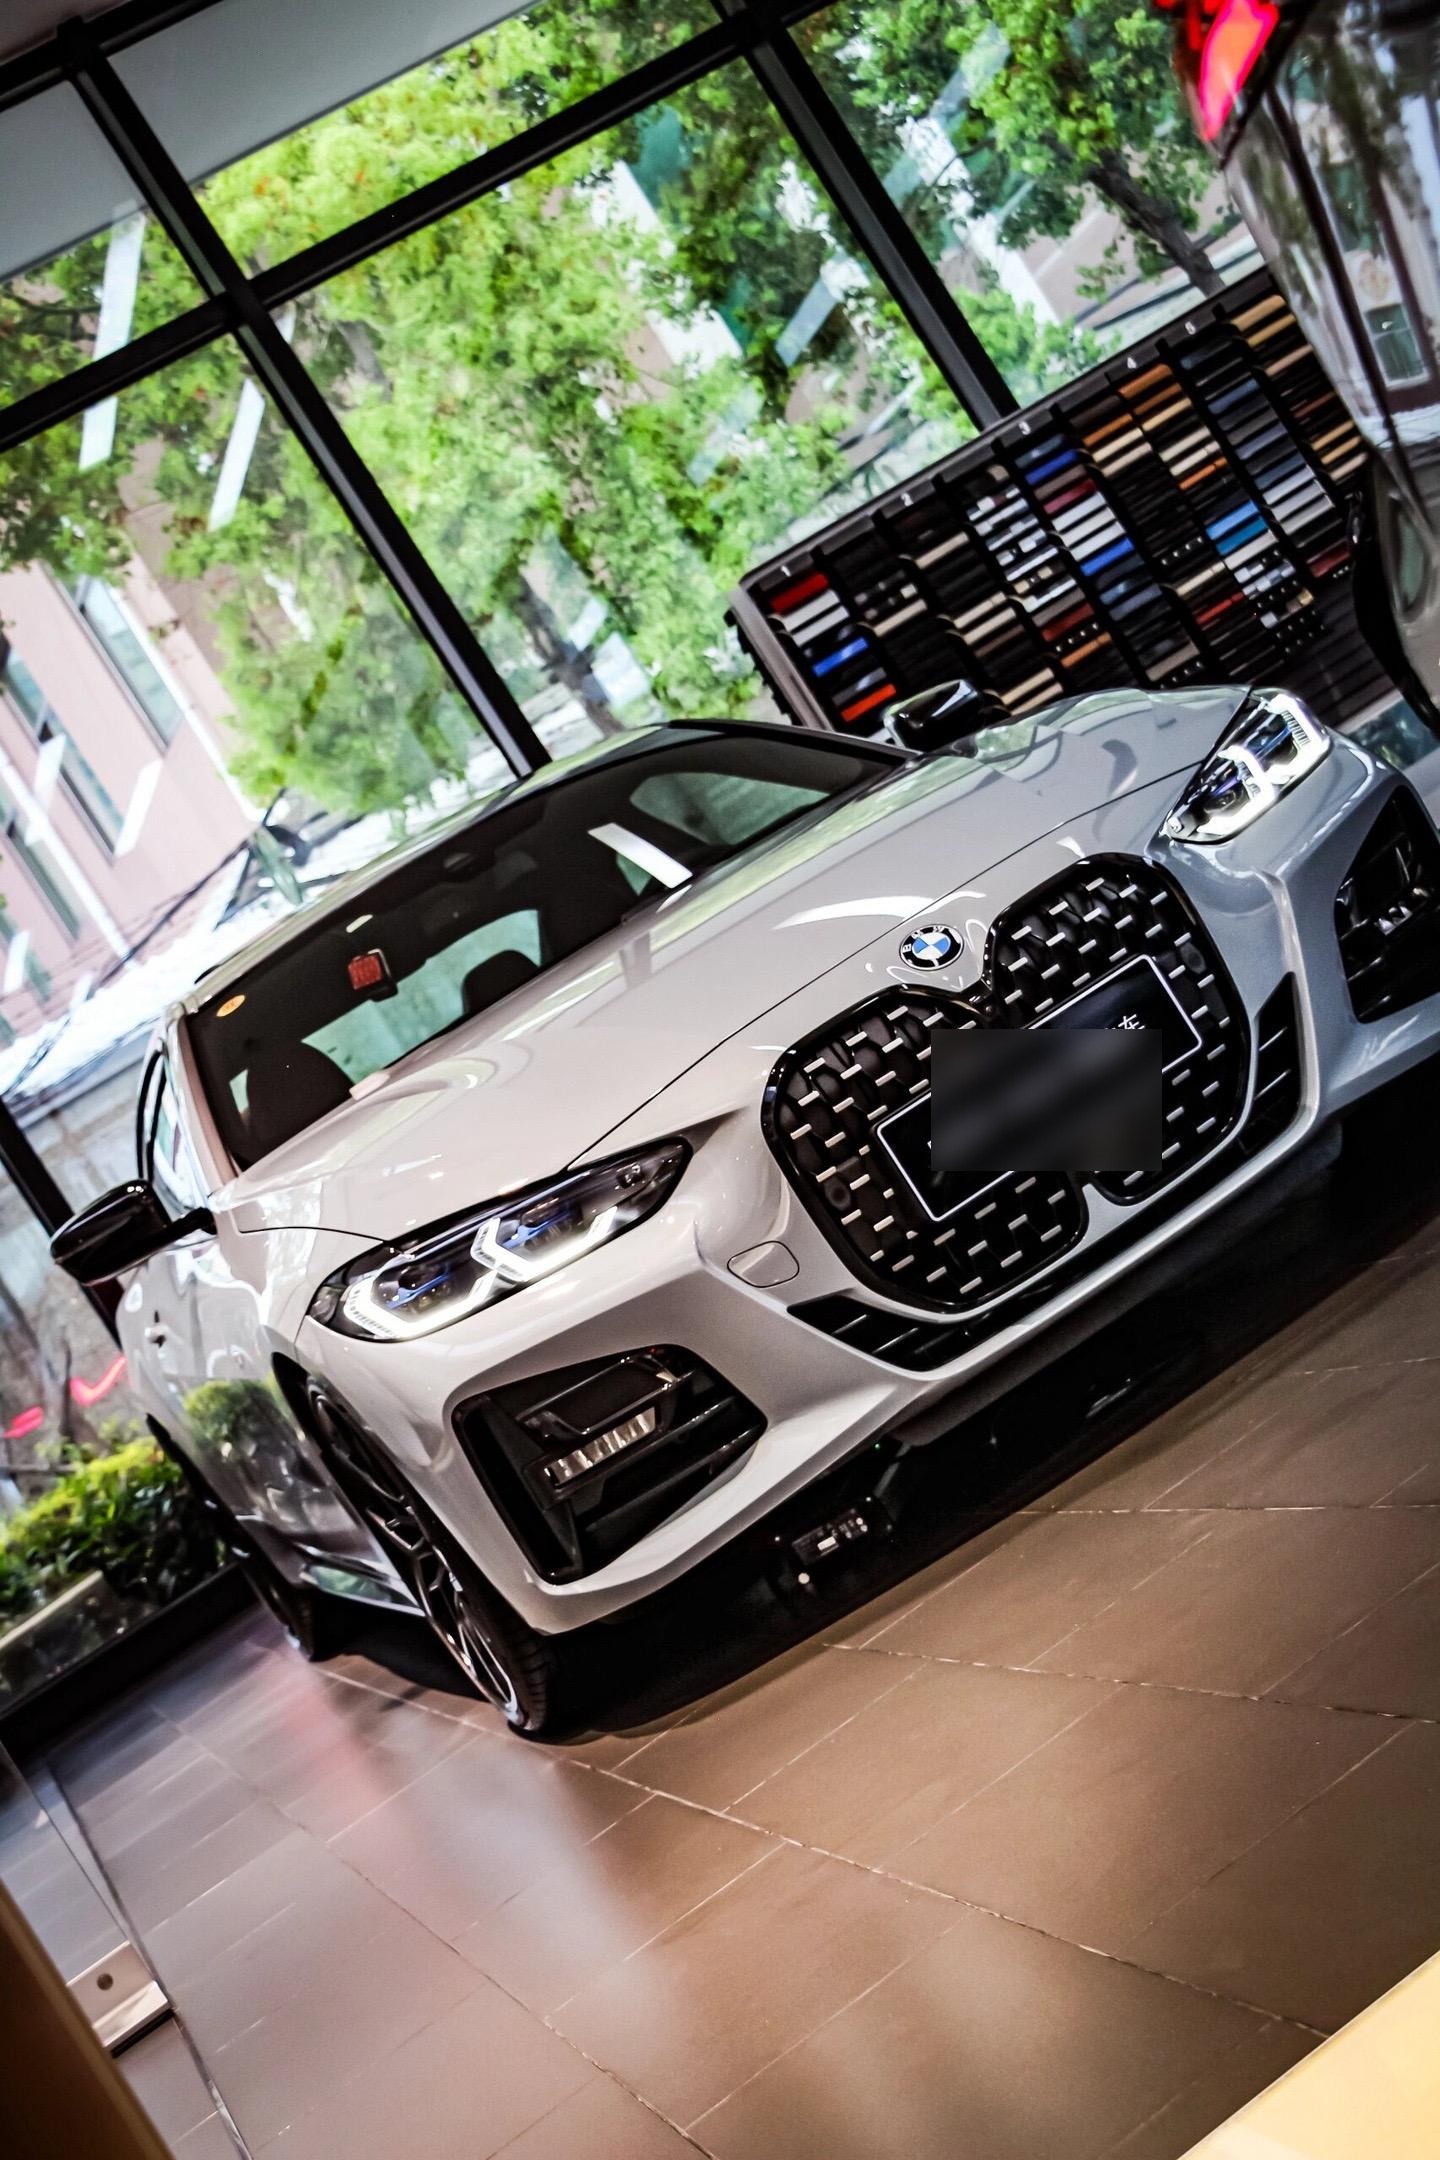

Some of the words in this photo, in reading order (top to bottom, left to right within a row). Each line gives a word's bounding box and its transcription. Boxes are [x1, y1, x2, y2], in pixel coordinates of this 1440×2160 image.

[1127, 356, 1137, 369] 4
[1019, 421, 1031, 435] 3
[901, 492, 914, 507] 2
[781, 565, 791, 577] 1
